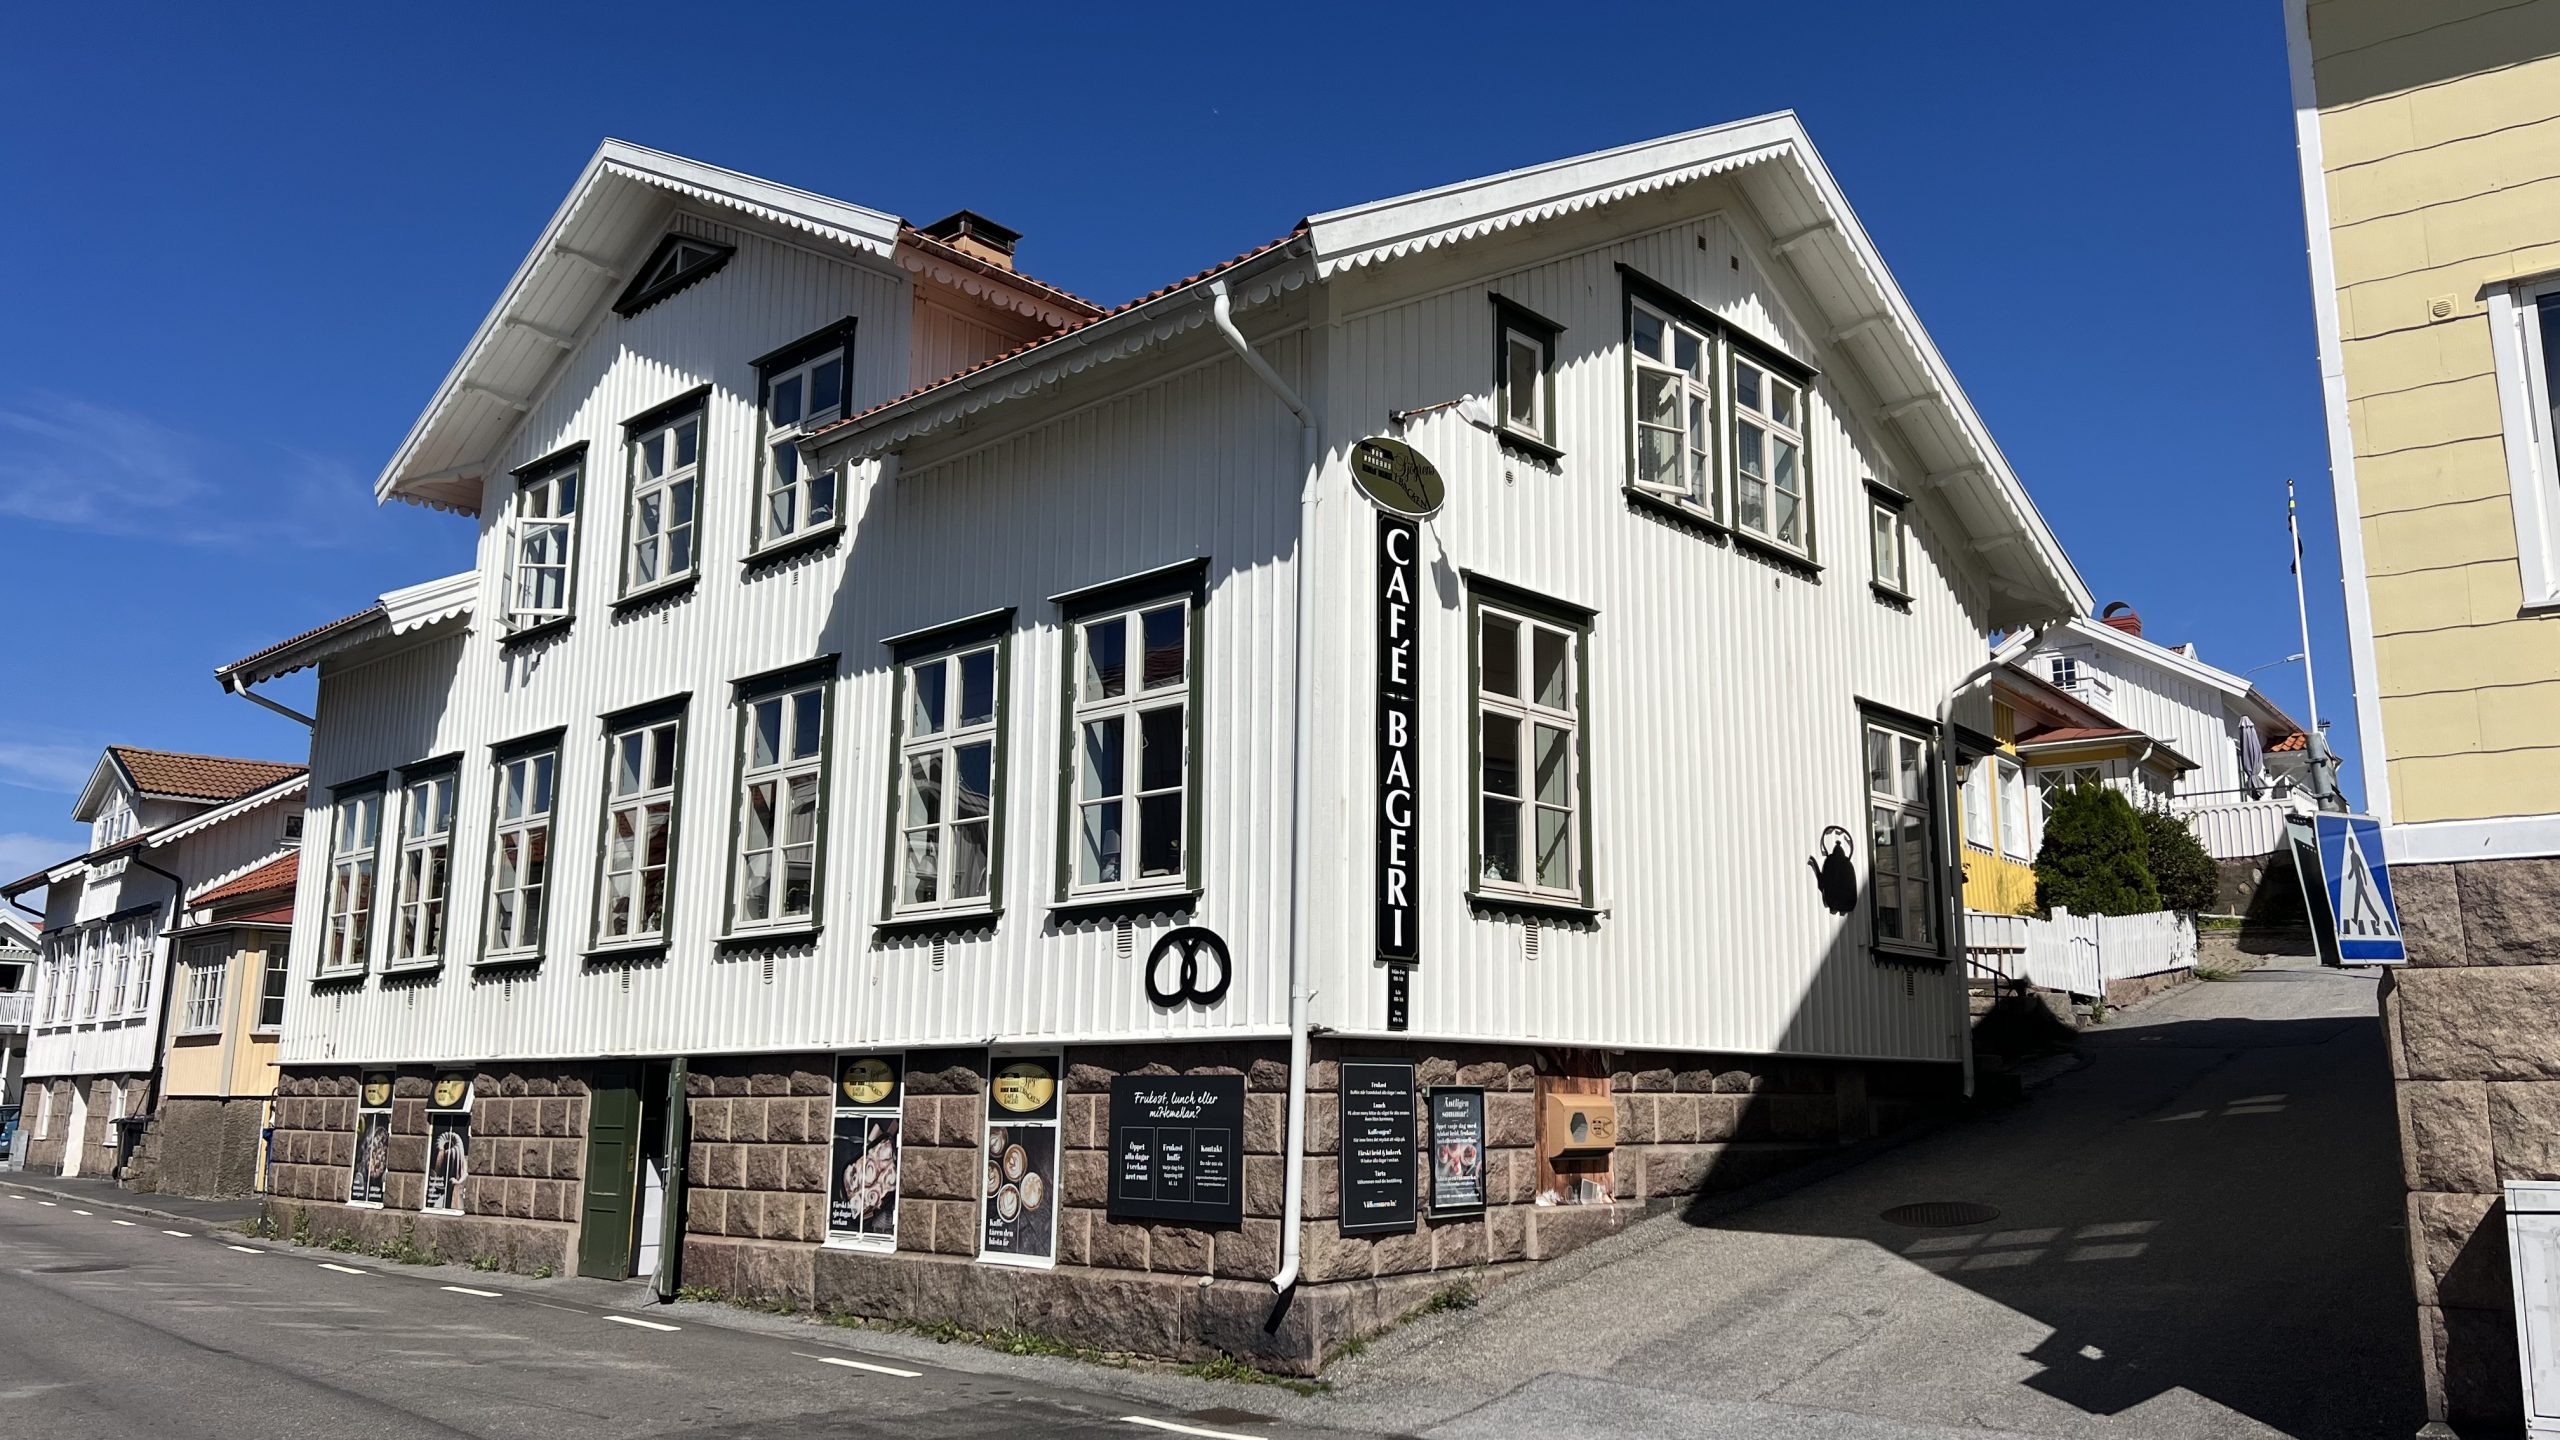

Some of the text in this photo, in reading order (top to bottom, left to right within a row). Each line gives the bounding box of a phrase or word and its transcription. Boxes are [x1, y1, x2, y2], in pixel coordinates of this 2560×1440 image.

[1386, 528, 1410, 684] CAFÉ
[1386, 710, 1411, 946] BAGERI
[325, 1043, 336, 1058] 34
[1134, 1091, 1218, 1105] Frukost, lunch eller
[1444, 1097, 1469, 1110] Äntligen
[1442, 1109, 1468, 1118] sommar!
